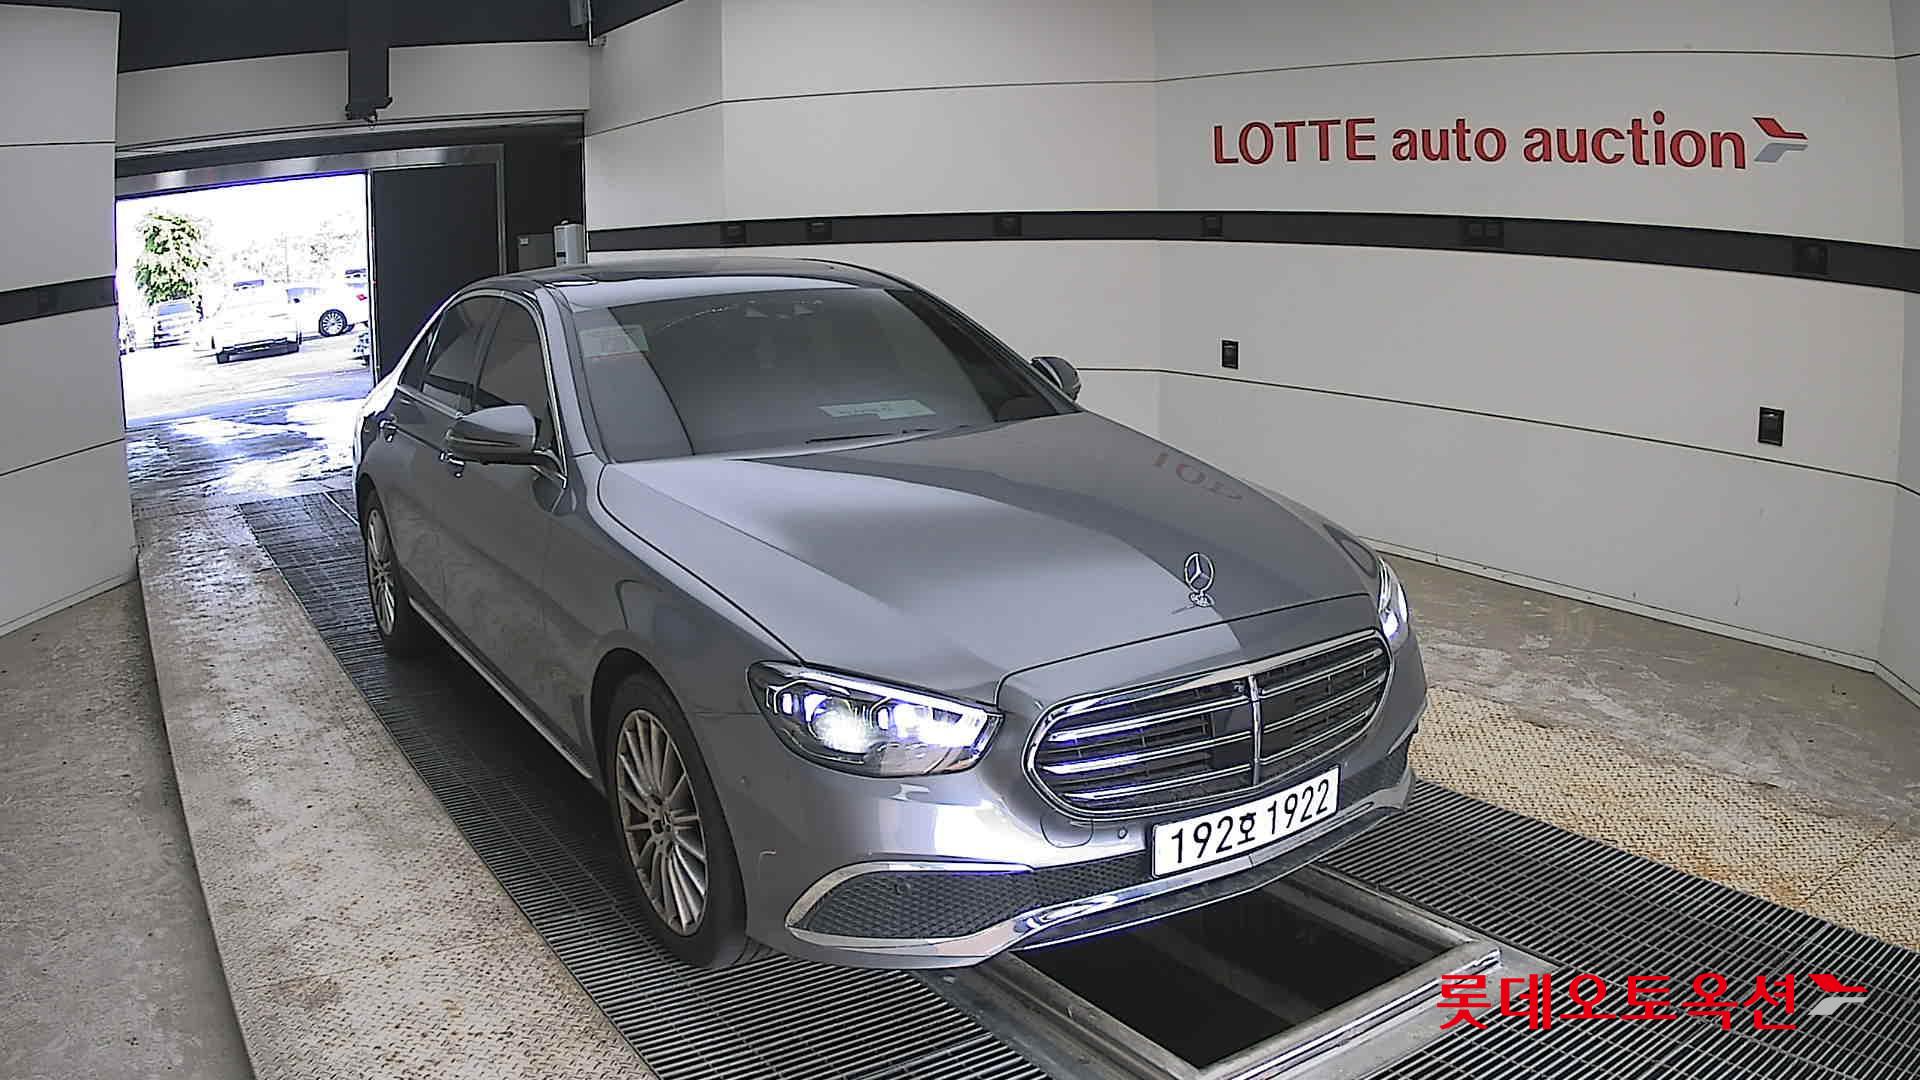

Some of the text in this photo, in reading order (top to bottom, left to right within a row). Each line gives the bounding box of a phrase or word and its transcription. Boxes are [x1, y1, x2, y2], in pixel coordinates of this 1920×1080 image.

[1213, 111, 1747, 170] LOTTE auto auction
